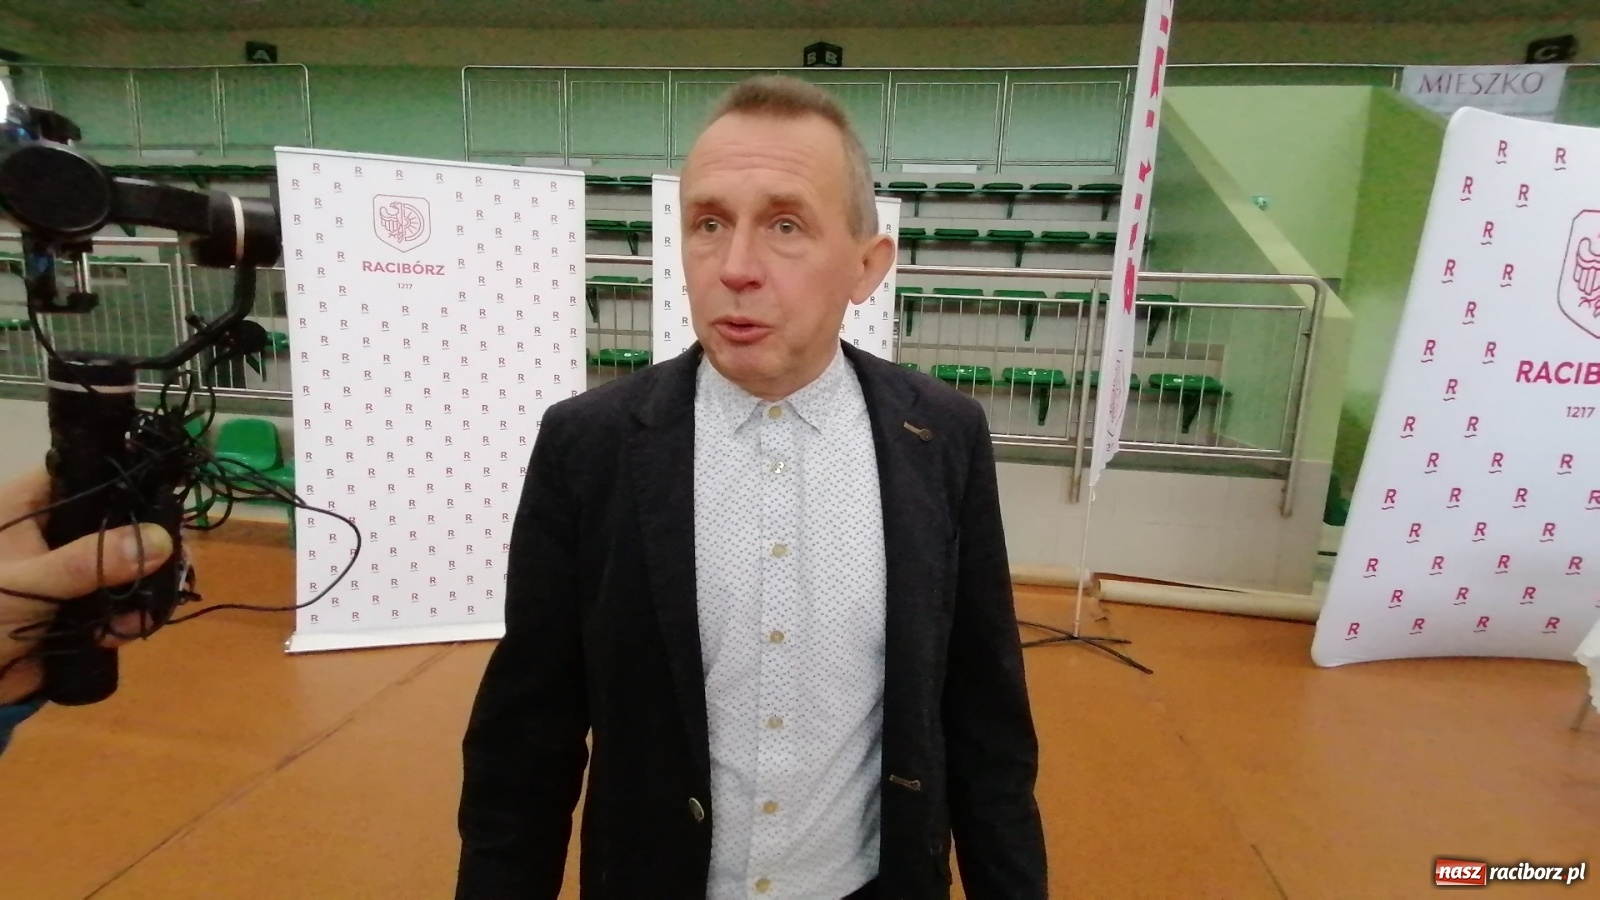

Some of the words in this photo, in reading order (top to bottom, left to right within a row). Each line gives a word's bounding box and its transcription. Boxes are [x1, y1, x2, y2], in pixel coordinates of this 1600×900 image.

[1417, 71, 1544, 95] MIESZKO
[1498, 140, 1508, 158] R
[1556, 147, 1566, 164] R
[312, 162, 320, 171] R
[396, 169, 404, 178] R
[292, 179, 300, 187] R
[334, 182, 342, 190] R
[1462, 176, 1473, 194] R
[456, 191, 463, 200] R
[1518, 184, 1529, 201] R
[531, 196, 538, 204] R
[568, 199, 575, 207] R
[294, 214, 301, 222] R
[476, 210, 484, 218] R
[335, 216, 343, 225] R
[495, 227, 502, 236] R
[1483, 221, 1494, 238] R
[316, 232, 324, 241] R
[568, 231, 576, 240] R
[295, 249, 303, 257] R
[458, 258, 466, 266] R
[362, 260, 445, 276] RACIBÓRZ
[569, 264, 576, 272] R
[1444, 259, 1456, 276] R
[1502, 264, 1514, 280] R
[478, 276, 485, 284] R
[338, 285, 346, 294] R
[533, 294, 540, 302] R
[319, 301, 327, 310] R
[402, 305, 409, 314] R
[1465, 301, 1477, 318] R
[479, 308, 486, 316] R
[299, 317, 307, 326] R
[381, 320, 390, 329] R
[460, 324, 468, 332] R
[534, 326, 541, 334] R
[320, 335, 329, 344] R
[362, 336, 370, 345] R
[442, 339, 449, 348] R
[517, 341, 524, 350] R
[1424, 340, 1436, 356] R
[1485, 342, 1496, 358] R
[301, 351, 308, 360] R
[383, 354, 390, 362] R
[422, 355, 430, 363] R
[498, 357, 506, 365] R
[364, 370, 372, 378] R
[480, 372, 488, 381] R
[343, 386, 351, 394] R
[1446, 378, 1458, 394] R
[423, 387, 431, 396] R
[365, 403, 373, 411] R
[518, 404, 526, 412] R
[1566, 406, 1596, 418] 1217
[304, 418, 311, 427] R
[385, 419, 393, 427] R
[1403, 416, 1416, 432] R
[1466, 416, 1479, 432] R
[325, 435, 333, 444] R
[406, 435, 414, 444] R
[445, 435, 452, 444] R
[519, 436, 526, 444] R
[305, 451, 313, 460] R
[386, 451, 394, 460] R
[1427, 452, 1439, 468] R
[1491, 452, 1504, 468] R
[1560, 454, 1573, 469] R
[326, 468, 334, 476] R
[483, 466, 490, 474] R
[347, 484, 355, 492] R
[464, 482, 472, 490] R
[1384, 489, 1396, 504] R
[1449, 488, 1462, 502] R
[1515, 488, 1528, 502] R
[1588, 490, 1600, 504] R
[328, 500, 336, 509] R
[307, 517, 315, 525] R
[1409, 523, 1421, 538] R
[1474, 522, 1487, 536] R
[1542, 522, 1556, 537] R
[370, 532, 378, 540] R
[1366, 558, 1378, 572] R
[1432, 556, 1444, 570] R
[1498, 555, 1510, 568] R
[1568, 556, 1583, 570] R
[429, 576, 436, 584] R
[1391, 590, 1403, 603] R
[1456, 587, 1469, 600] R
[1522, 586, 1536, 599] R
[1413, 618, 1425, 630] R
[1477, 616, 1490, 628] R
[1546, 617, 1560, 629] R
[1348, 622, 1360, 635] R
